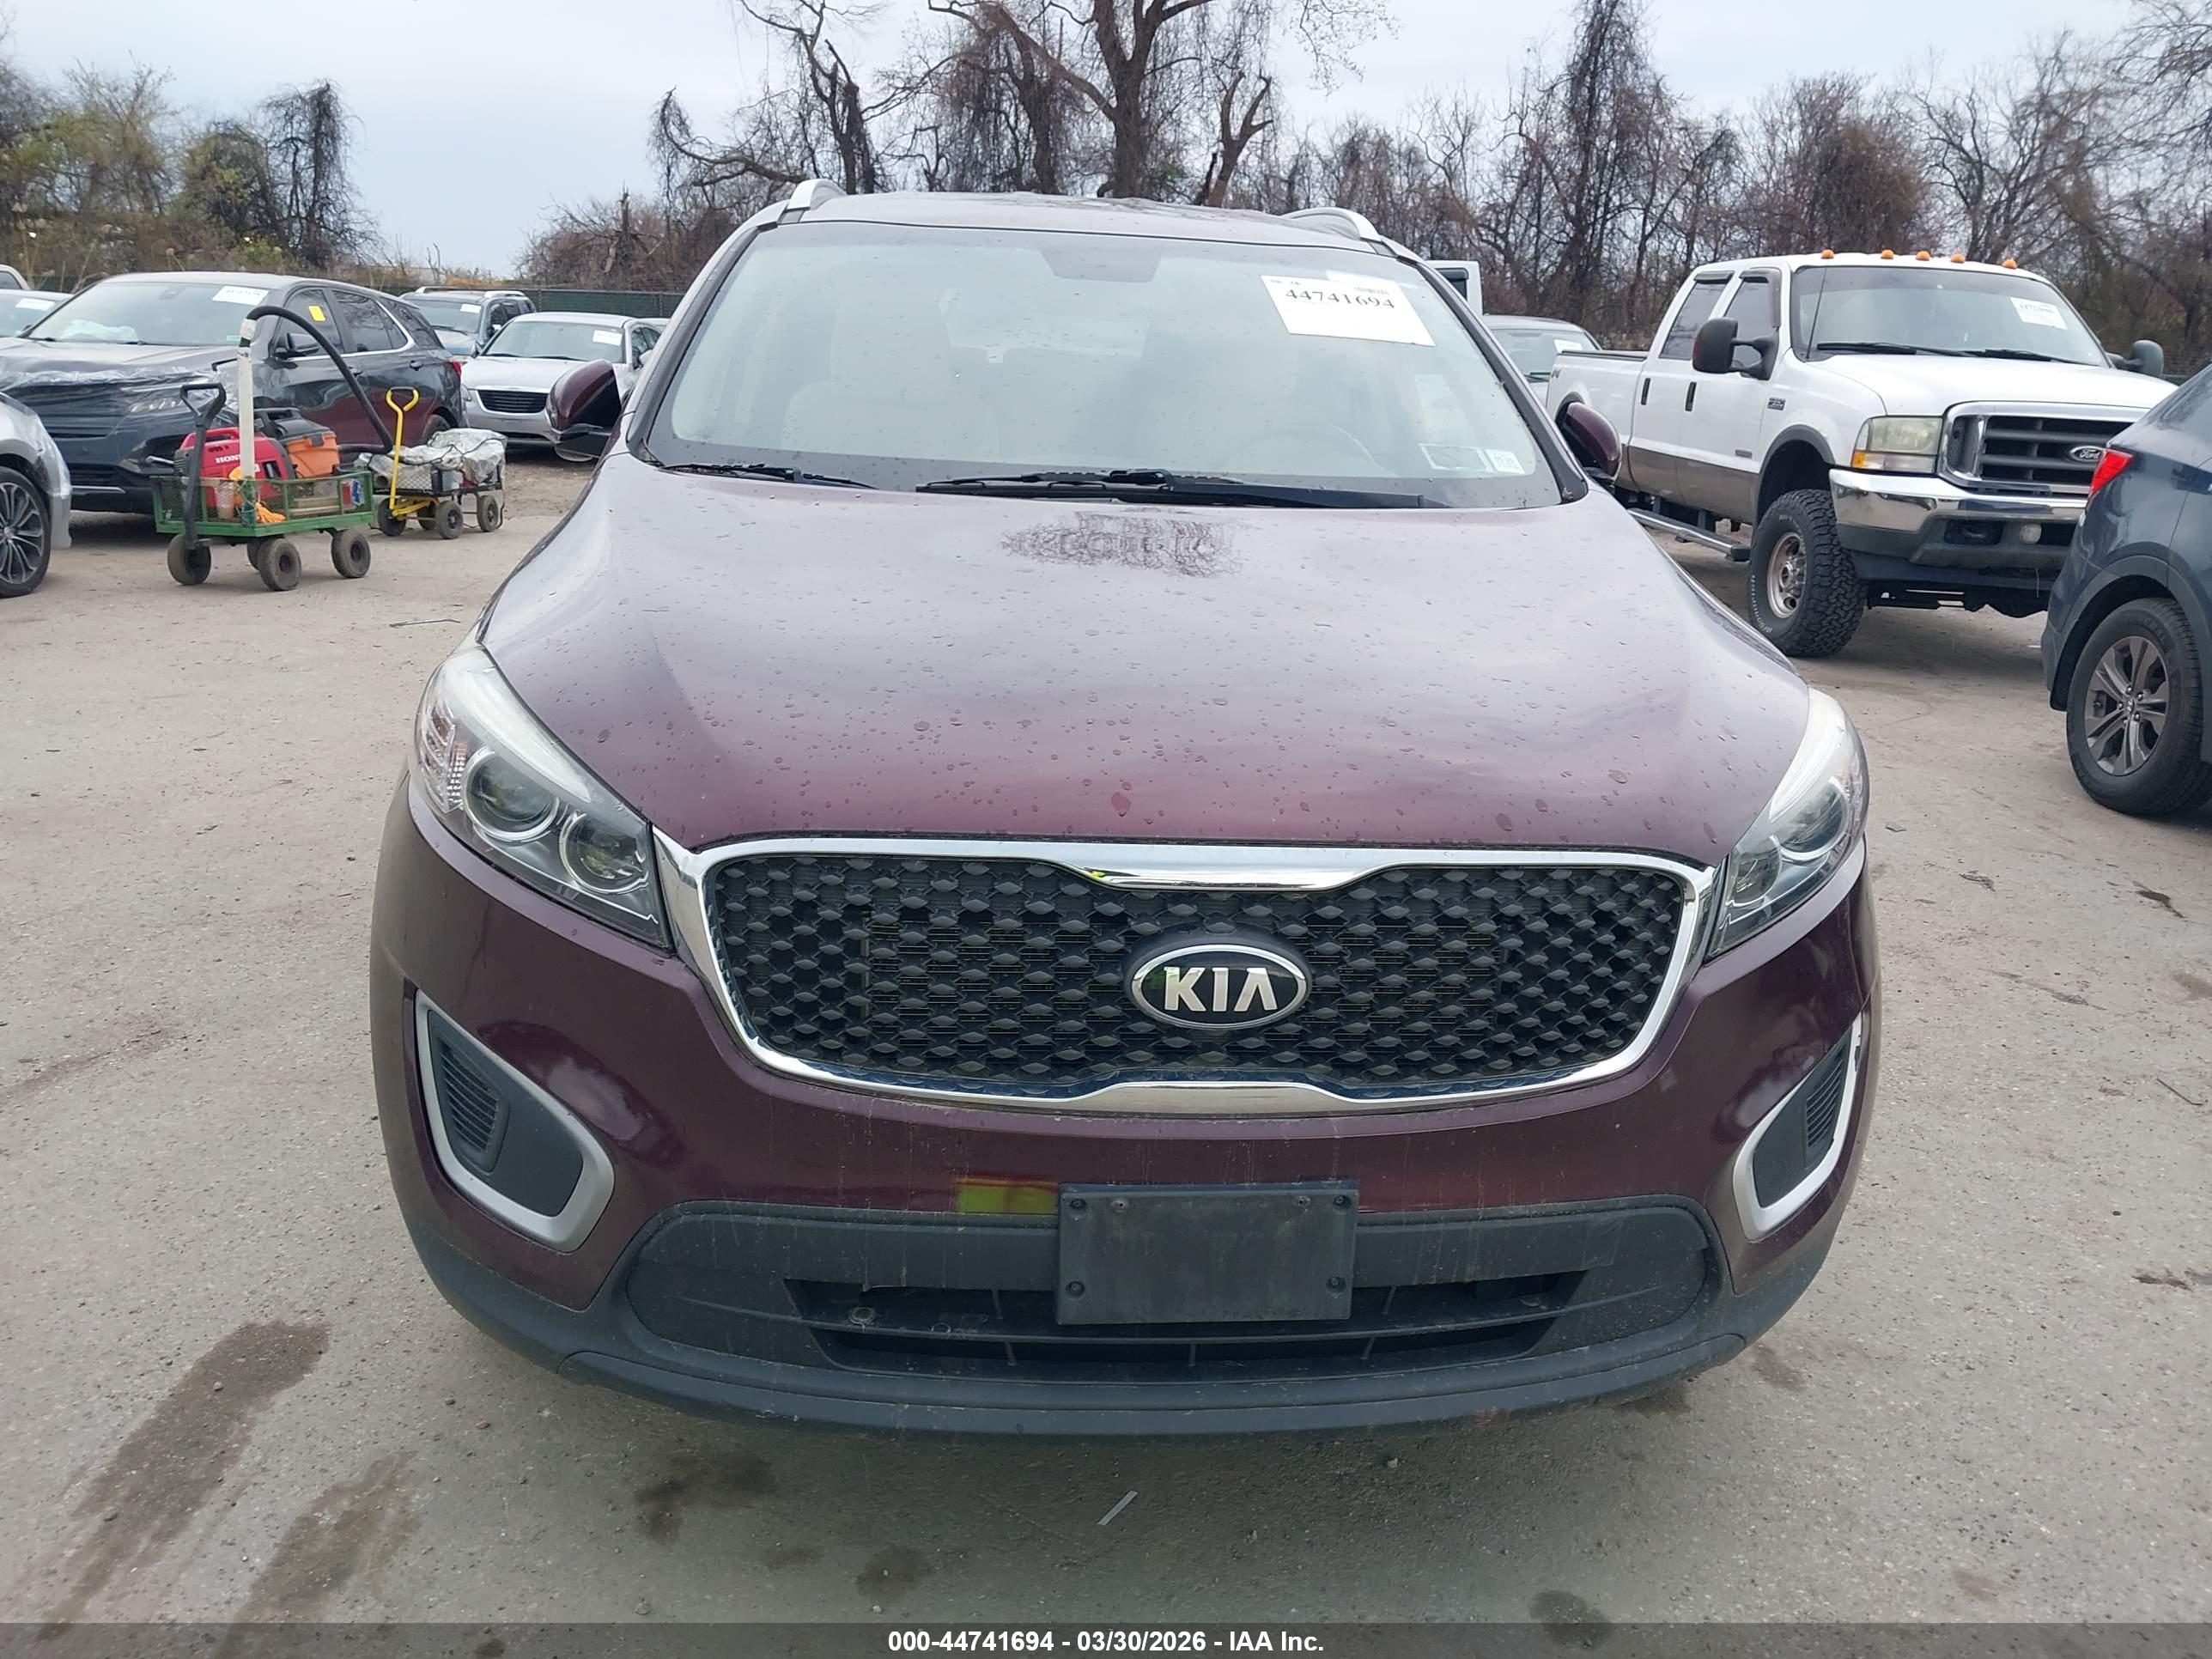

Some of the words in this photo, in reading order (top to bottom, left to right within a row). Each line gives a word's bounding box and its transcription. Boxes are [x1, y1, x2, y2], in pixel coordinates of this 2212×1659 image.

[1285, 289, 1395, 308] 44741694
[216, 454, 241, 464] HON
[1164, 966, 1278, 1012] KIA
